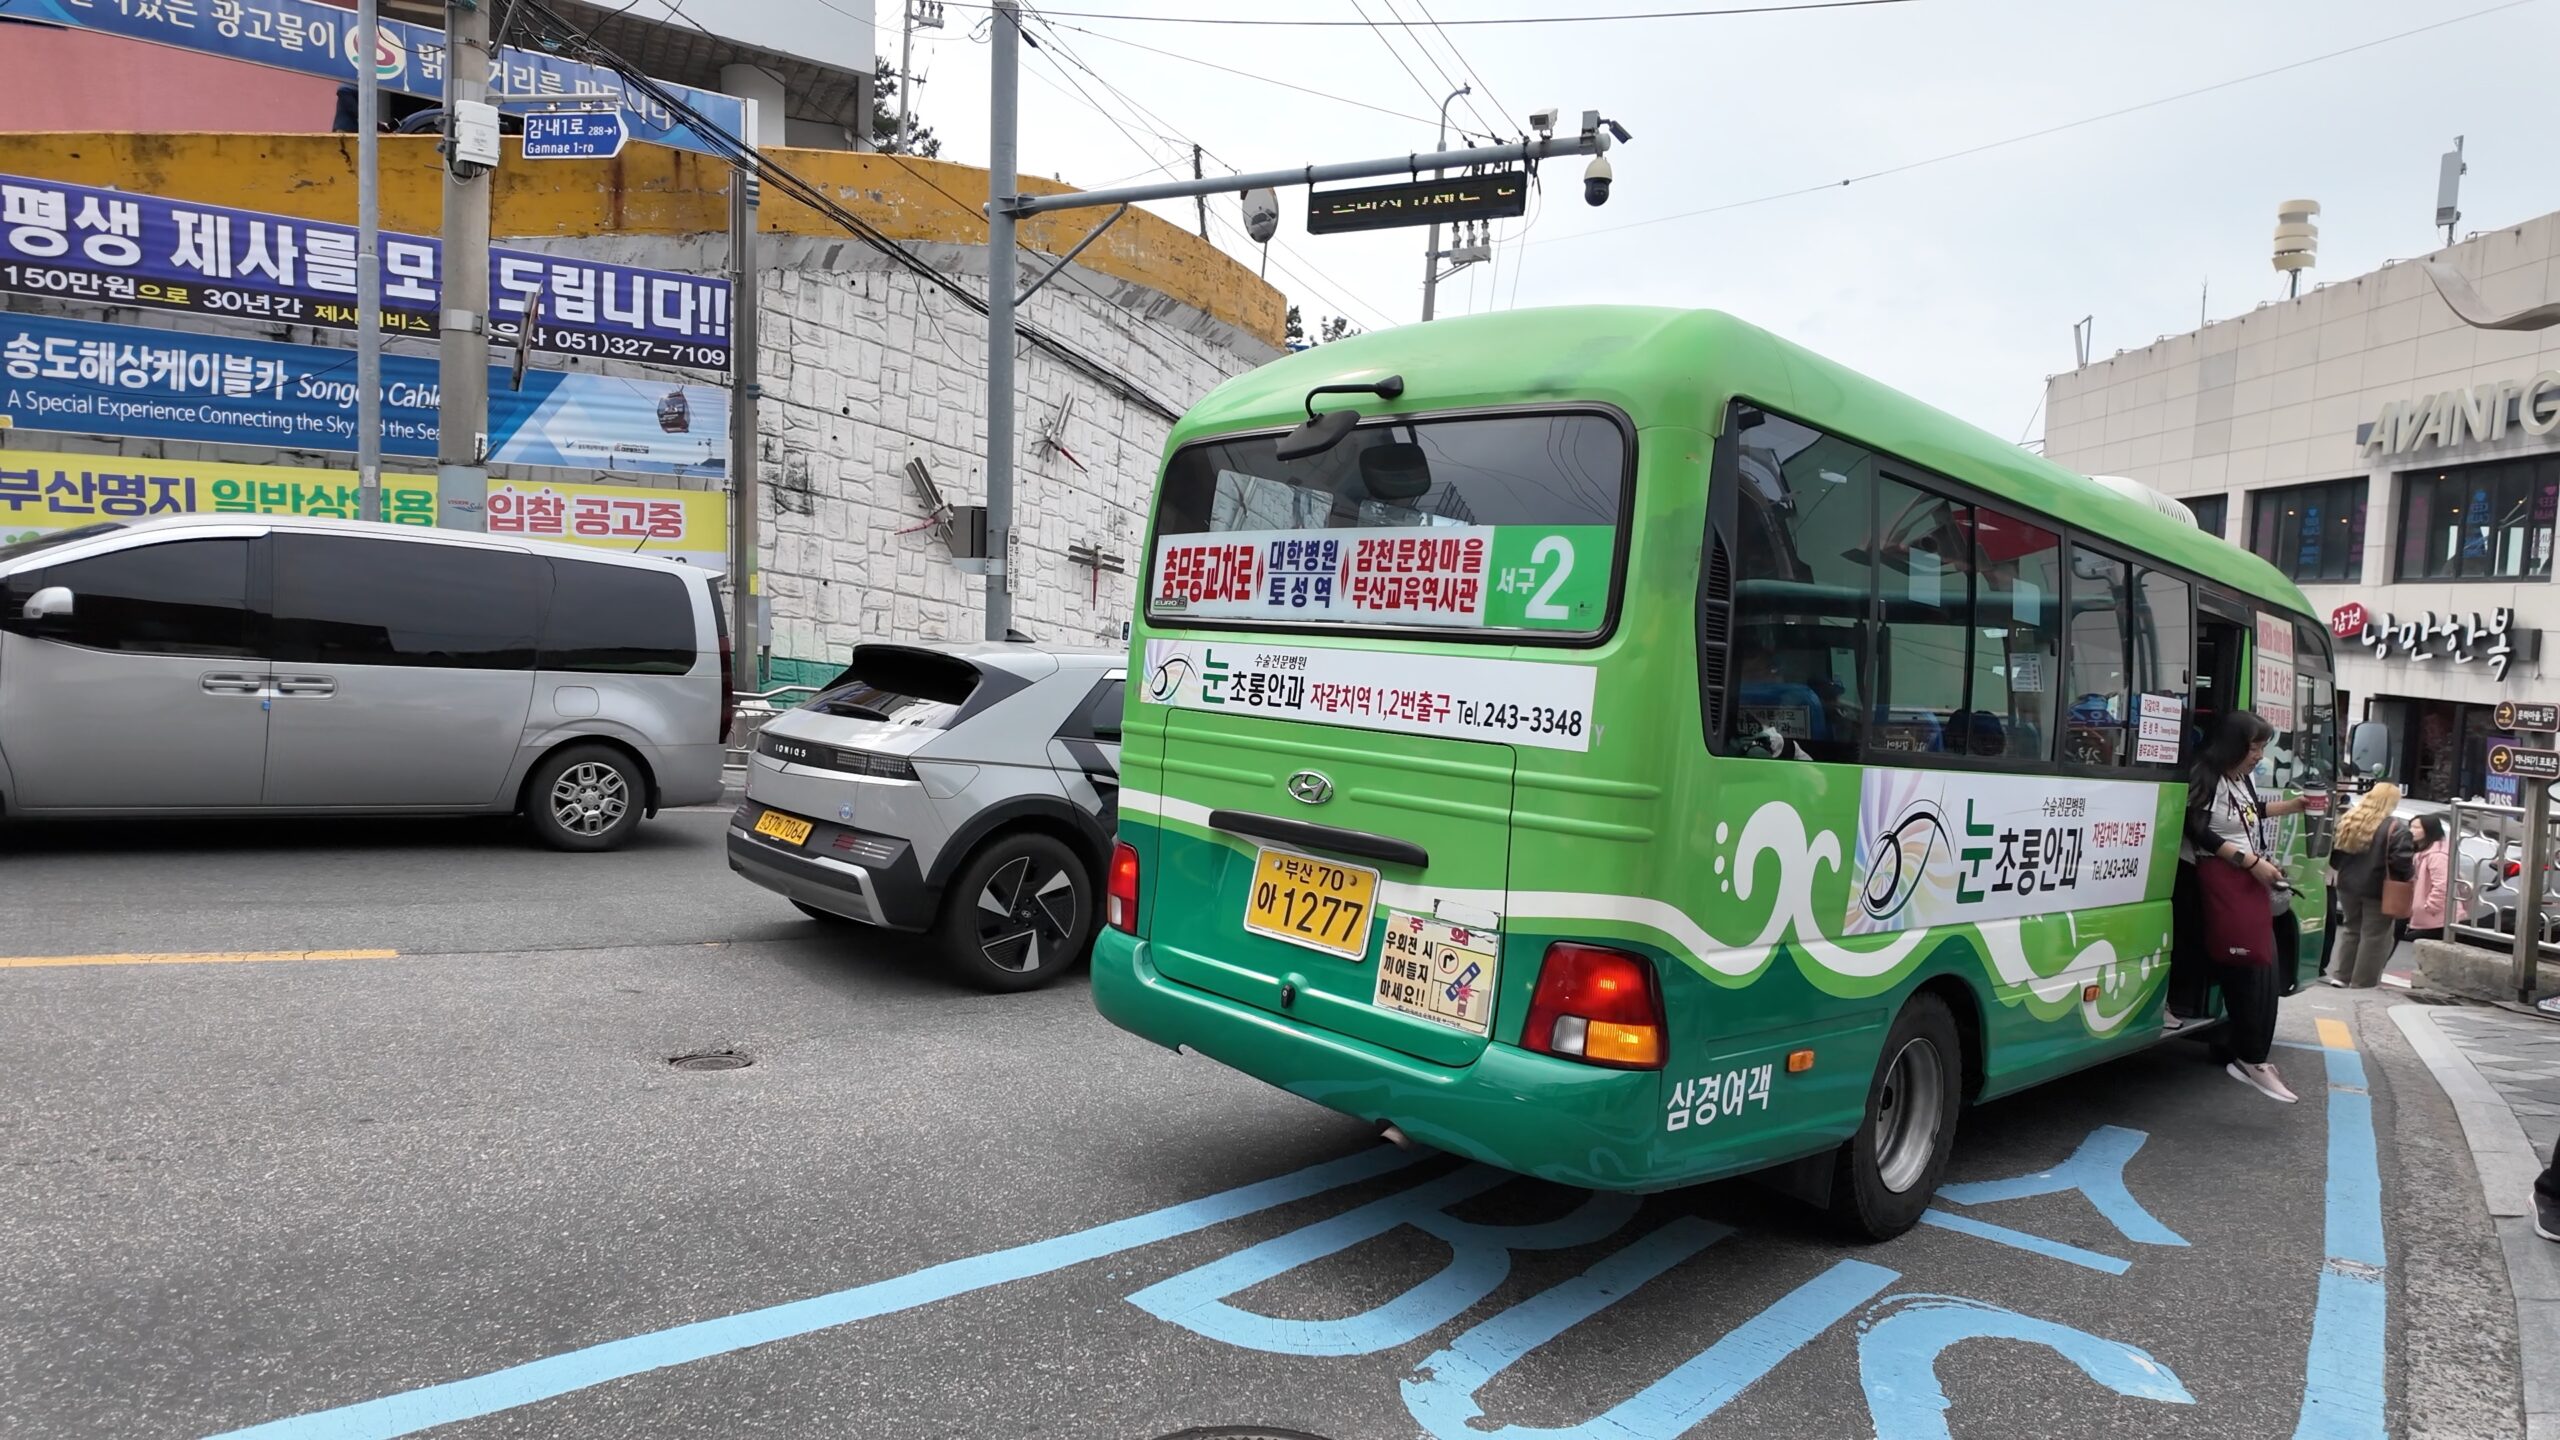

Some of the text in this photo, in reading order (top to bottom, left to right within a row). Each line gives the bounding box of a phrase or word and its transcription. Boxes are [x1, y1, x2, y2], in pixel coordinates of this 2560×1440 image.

[211, 0, 337, 59] 광고물이
[528, 118, 585, 140] 감내1로
[527, 142, 594, 154] Gamnae 1-ro
[1, 184, 142, 267] 평생
[169, 209, 358, 294] 제사를
[4, 265, 191, 305] 150만원으로
[203, 289, 304, 319] 30년간
[314, 304, 431, 332] 제사비스
[4, 332, 289, 400] 송도해상케이블카
[296, 373, 384, 409] Song
[8, 390, 21, 408] A
[38, 390, 93, 416] Special
[98, 396, 196, 423] Experience
[199, 405, 293, 434] Connecting
[296, 413, 323, 432] the
[326, 415, 355, 439] Sky
[389, 420, 415, 439] the
[0, 468, 197, 515] 부산명지
[488, 494, 566, 533] 입찰
[575, 499, 683, 538] 공고중
[1268, 540, 1339, 571] 대학병원
[1356, 538, 1484, 574] 감천문화마을
[1161, 544, 1255, 603] 충무동교차로
[1496, 535, 1575, 620] 서구 2
[1268, 576, 1332, 609] 토성역
[1352, 576, 1478, 613] 부산교육역사관
[2332, 607, 2362, 633] 감천
[2361, 606, 2512, 683] 낭만한복
[1254, 653, 1308, 671] 수술전문병원
[1310, 682, 1372, 716] 자갈치역
[1377, 688, 1451, 724] 1,2번출구
[1457, 699, 1582, 737] Tel.243-3348
[2486, 775, 2516, 794] BUSAN
[2489, 792, 2512, 806] PASS
[2042, 796, 2086, 818] 수술전문병원
[2092, 821, 2119, 849] 자갈치역
[1285, 859, 1345, 892] 부산 70
[1385, 930, 1434, 960] 우회전 시
[1383, 955, 1429, 984] 끼어들지
[1380, 978, 1425, 1008] 마세요!!
[1666, 1064, 1773, 1132] 삼경여객
